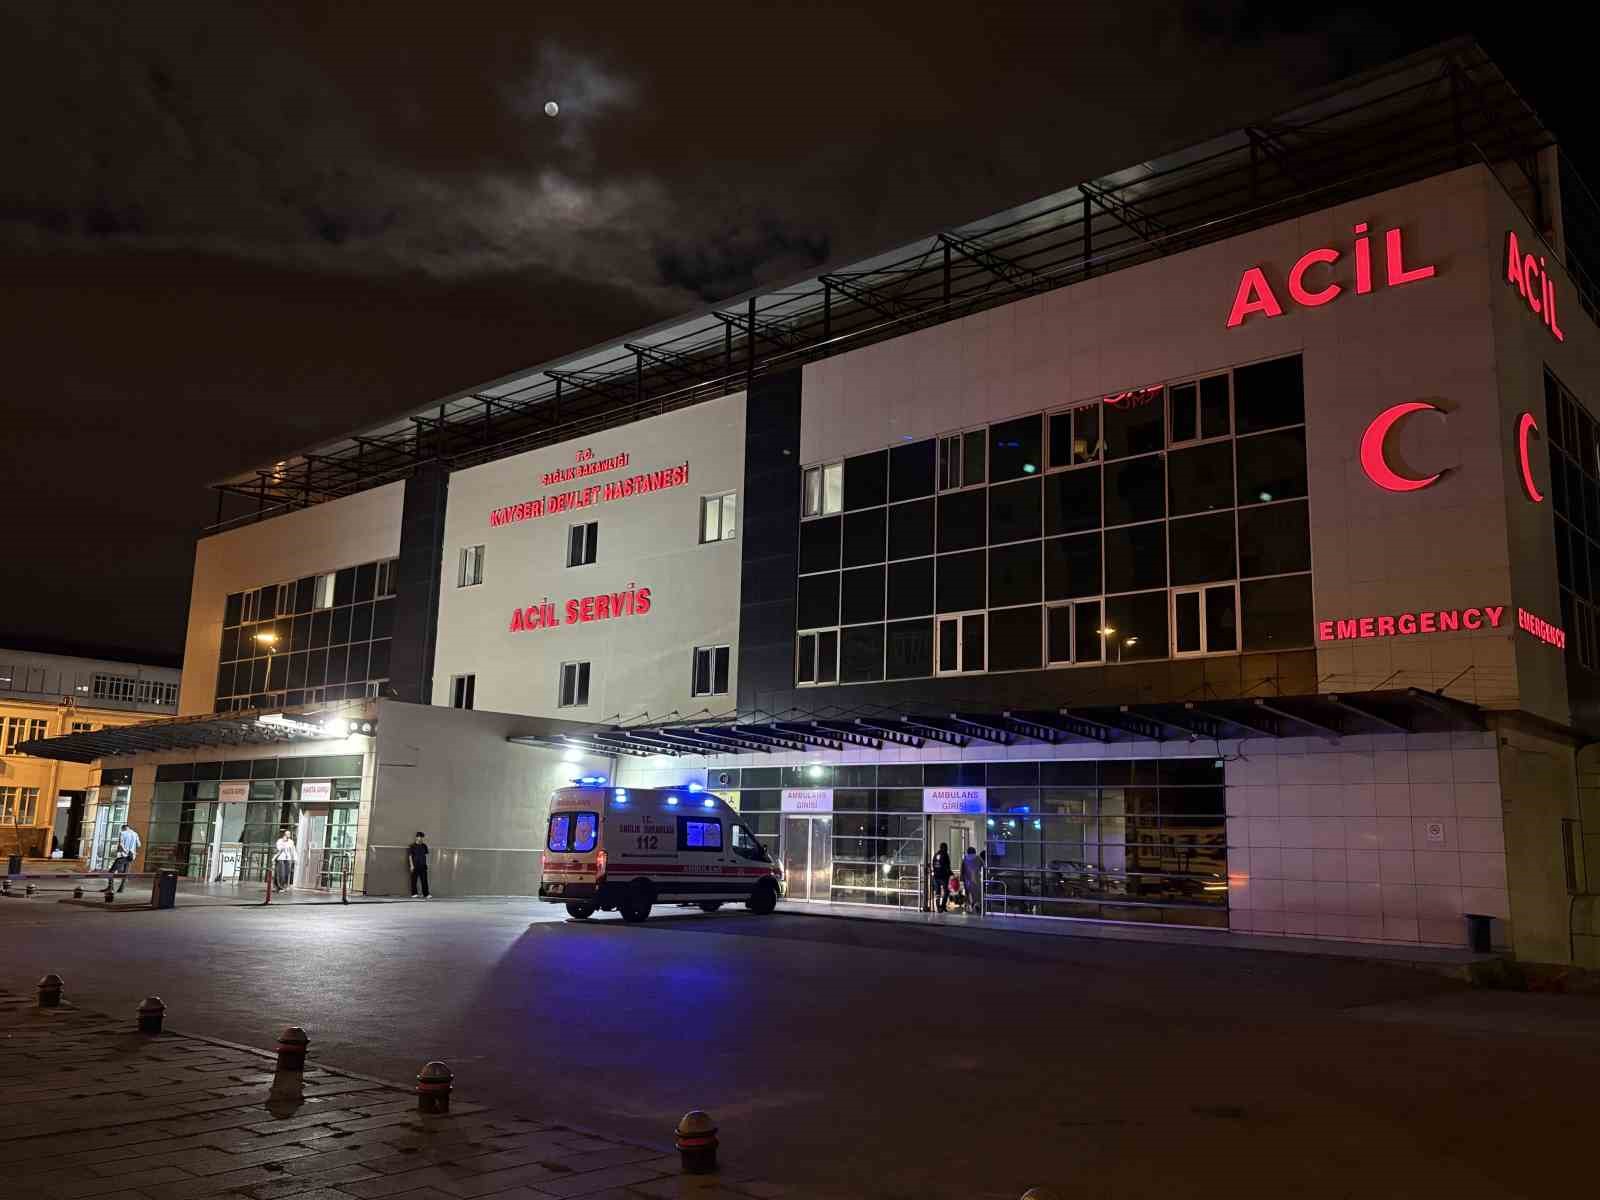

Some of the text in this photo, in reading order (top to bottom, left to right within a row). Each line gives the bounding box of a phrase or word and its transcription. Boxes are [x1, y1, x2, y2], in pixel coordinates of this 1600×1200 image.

[1225, 222, 1436, 329] ACİL
[1506, 230, 1565, 343] ACİL
[489, 460, 689, 528] KAYSERİ DEVLET HASTANESİ
[509, 582, 651, 632] ACİL SERVİS
[1318, 606, 1506, 641] EMERGENCY
[1518, 607, 1567, 650] EMERGENCY
[931, 790, 979, 800] AMBULANS
[635, 834, 659, 850] 112
